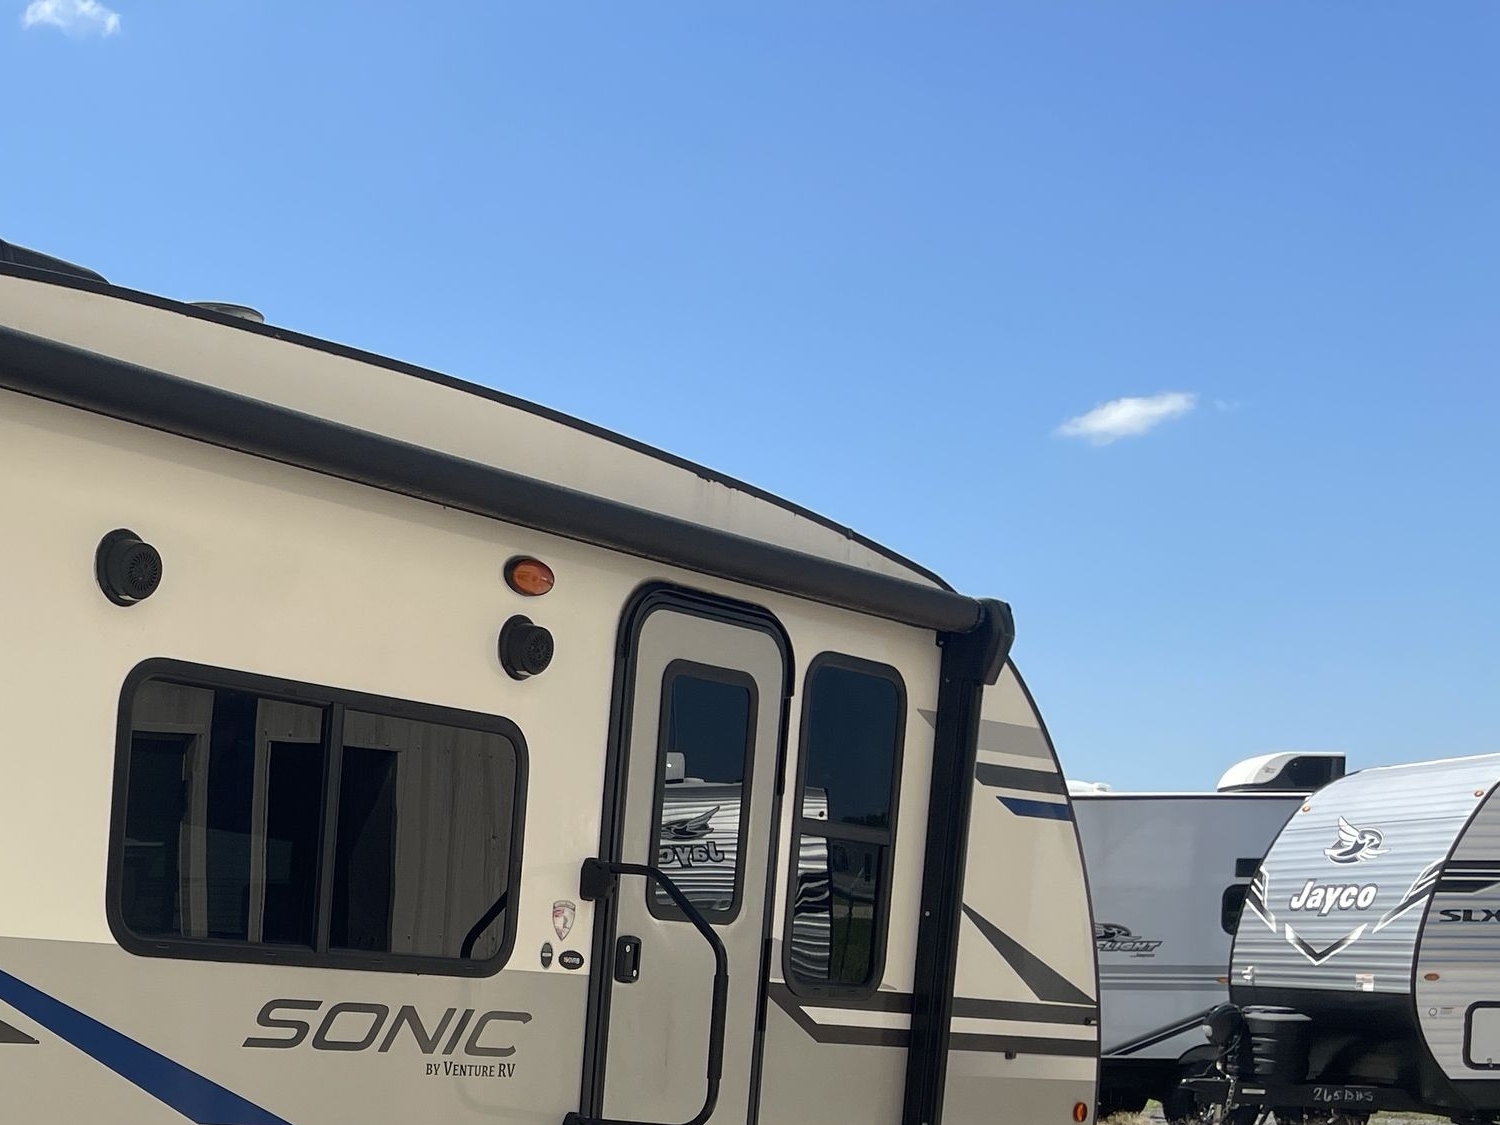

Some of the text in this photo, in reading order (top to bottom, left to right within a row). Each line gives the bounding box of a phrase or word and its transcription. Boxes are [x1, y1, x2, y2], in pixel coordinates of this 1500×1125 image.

[1289, 878, 1379, 917] Jayco
[241, 998, 534, 1058] SONIC
[497, 1063, 517, 1078] RV
